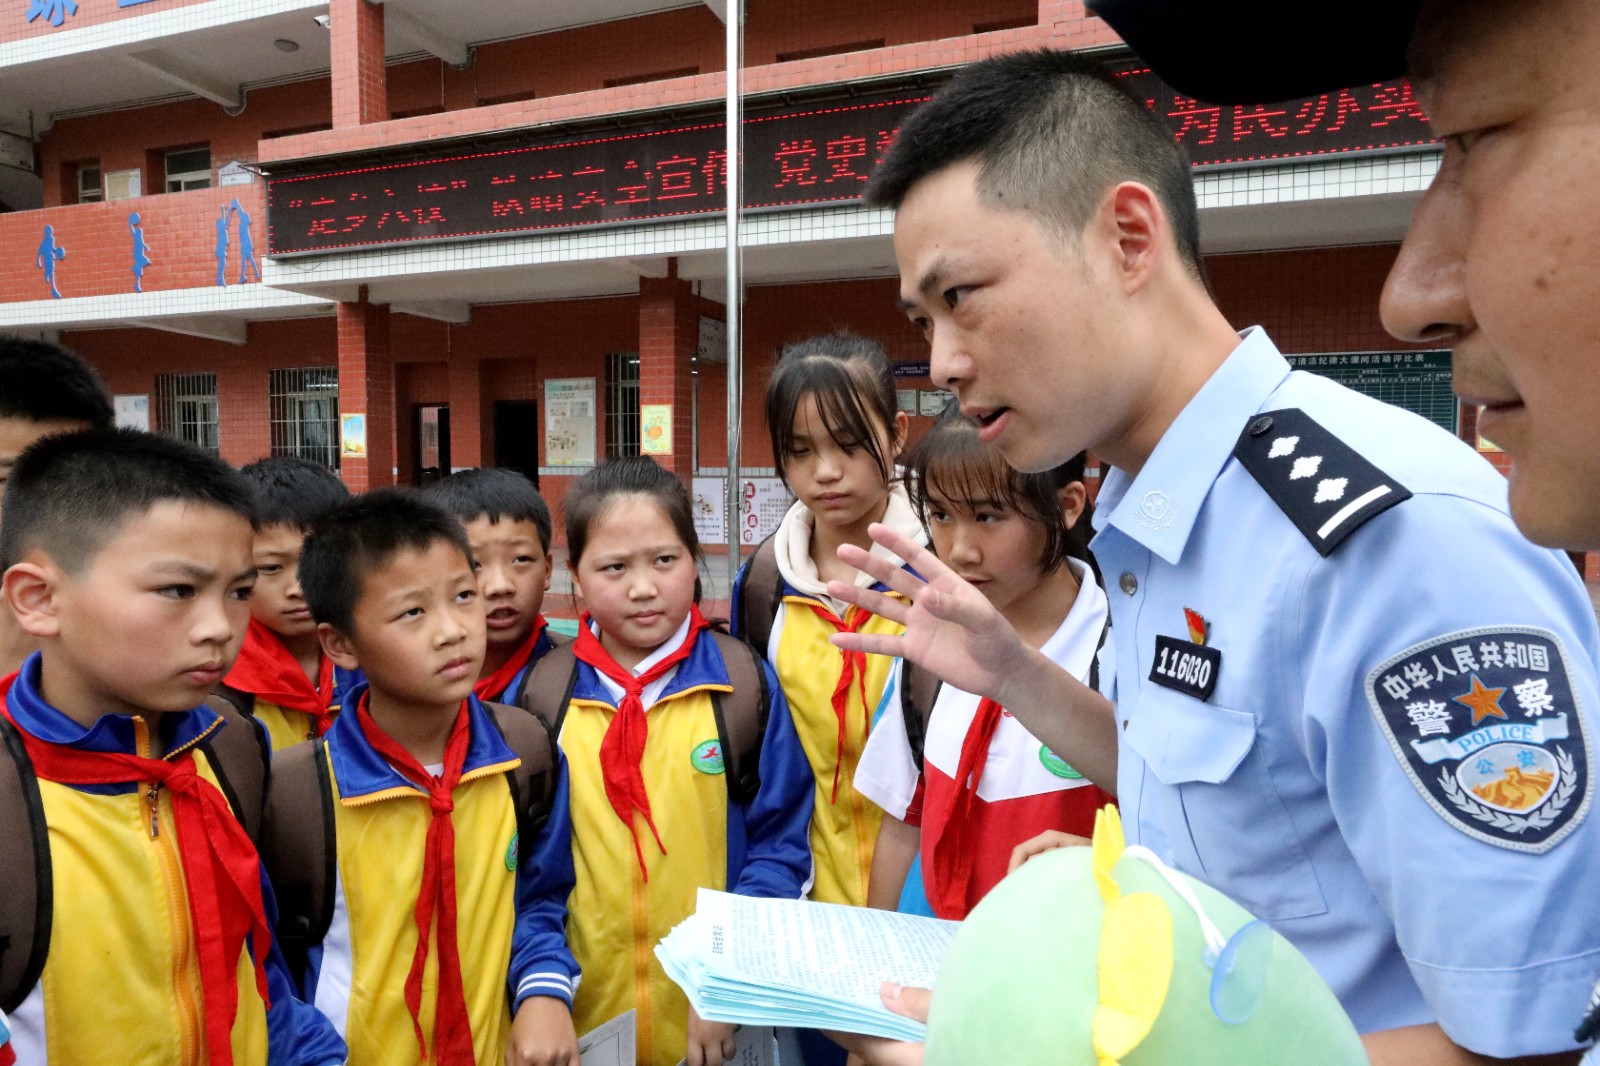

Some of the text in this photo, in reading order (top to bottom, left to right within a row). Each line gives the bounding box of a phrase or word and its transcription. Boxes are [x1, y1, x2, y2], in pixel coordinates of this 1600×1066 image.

[1156, 646, 1212, 689] 116030
[1382, 641, 1550, 702] 中华人民共和国
[1404, 678, 1554, 737] 警 察
[1457, 724, 1534, 753] POLICE
[1475, 757, 1495, 775] 公
